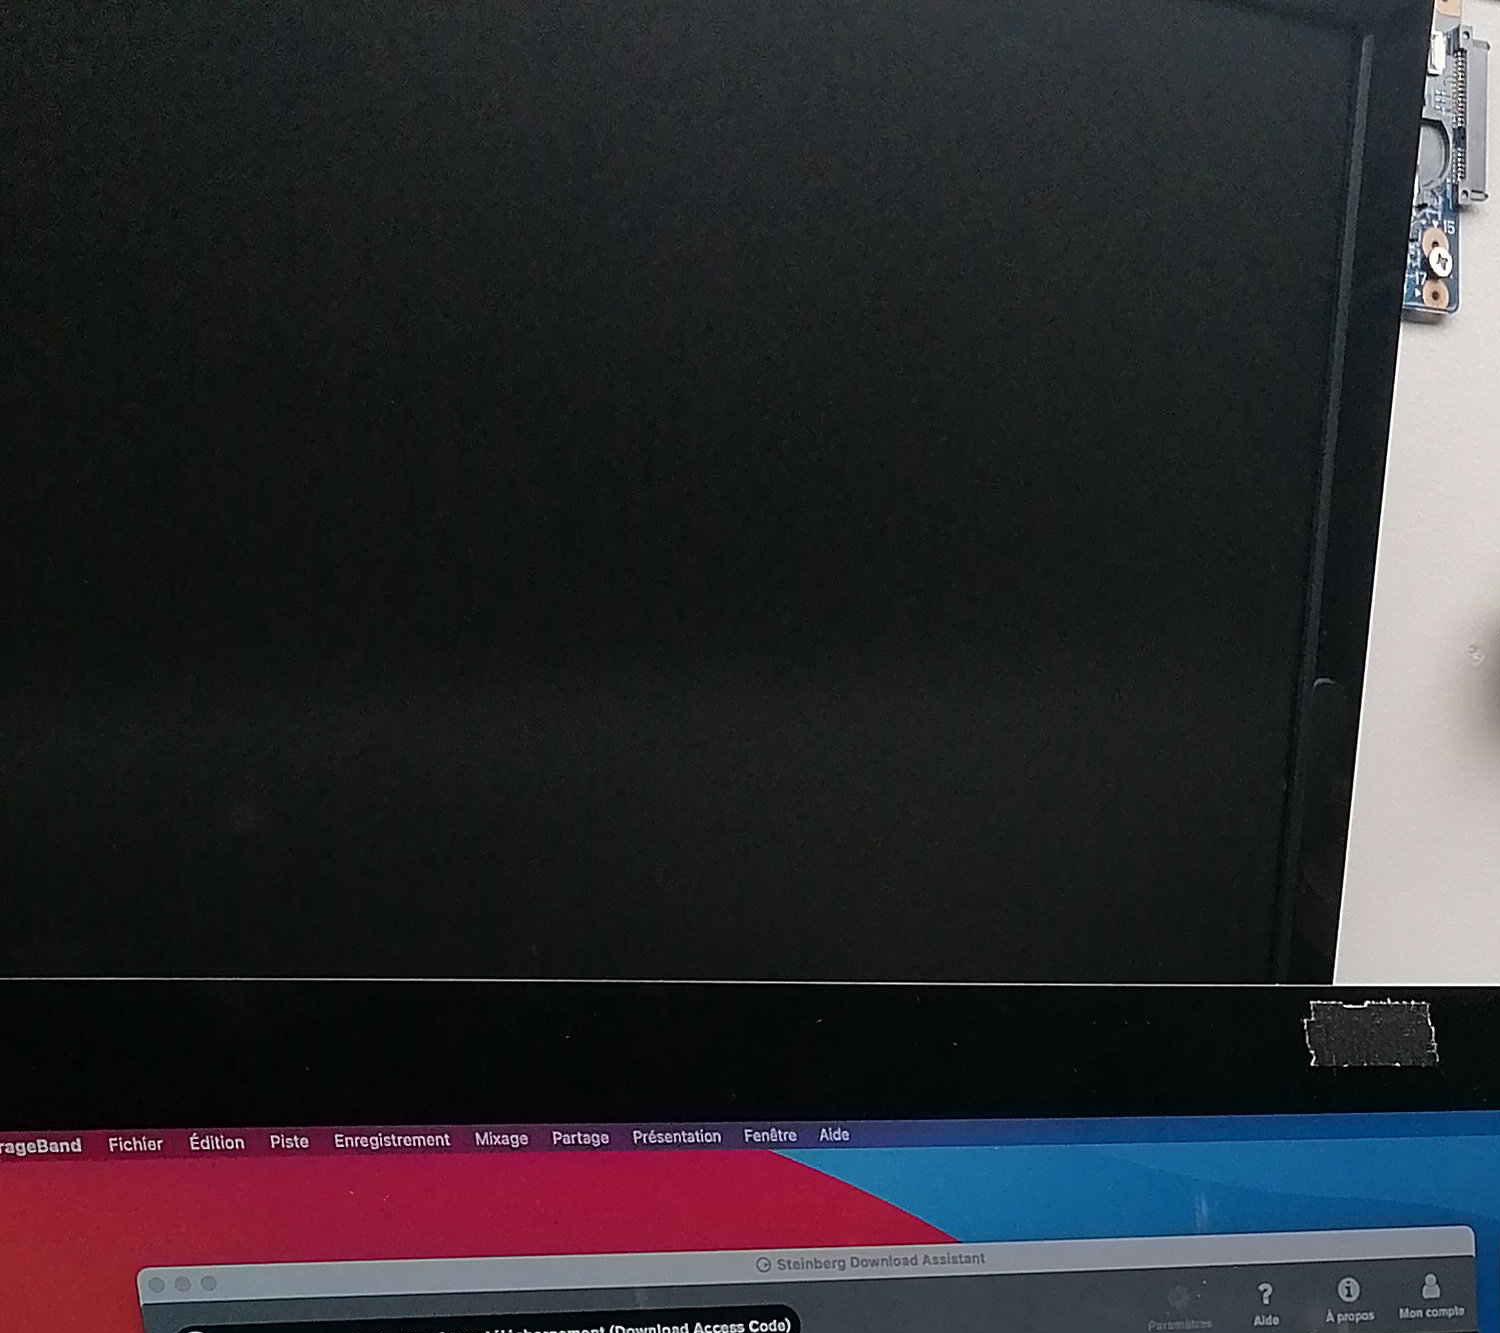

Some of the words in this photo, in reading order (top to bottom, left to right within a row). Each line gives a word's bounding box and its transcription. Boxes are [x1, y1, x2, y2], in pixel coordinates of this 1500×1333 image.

[108, 1136, 164, 1152] Fichier
[190, 1132, 246, 1151] Édition
[270, 1134, 310, 1149] Piste
[335, 1130, 451, 1151] Enregistrement
[475, 1130, 529, 1148] Mixage
[552, 1130, 610, 1146] Partage
[632, 1128, 721, 1144] Présentation
[744, 1128, 798, 1142] Fenêtre
[819, 1128, 850, 1141] Aide
[776, 1256, 846, 1272] Steinberg
[850, 1254, 919, 1269] Download
[922, 1252, 986, 1266] Assistant
[1336, 1310, 1376, 1323] propos
[1400, 1307, 1424, 1320] Mon
[1426, 1306, 1466, 1318] compte
[748, 1318, 792, 1333] Code)
[1254, 1314, 1280, 1327] Aide
